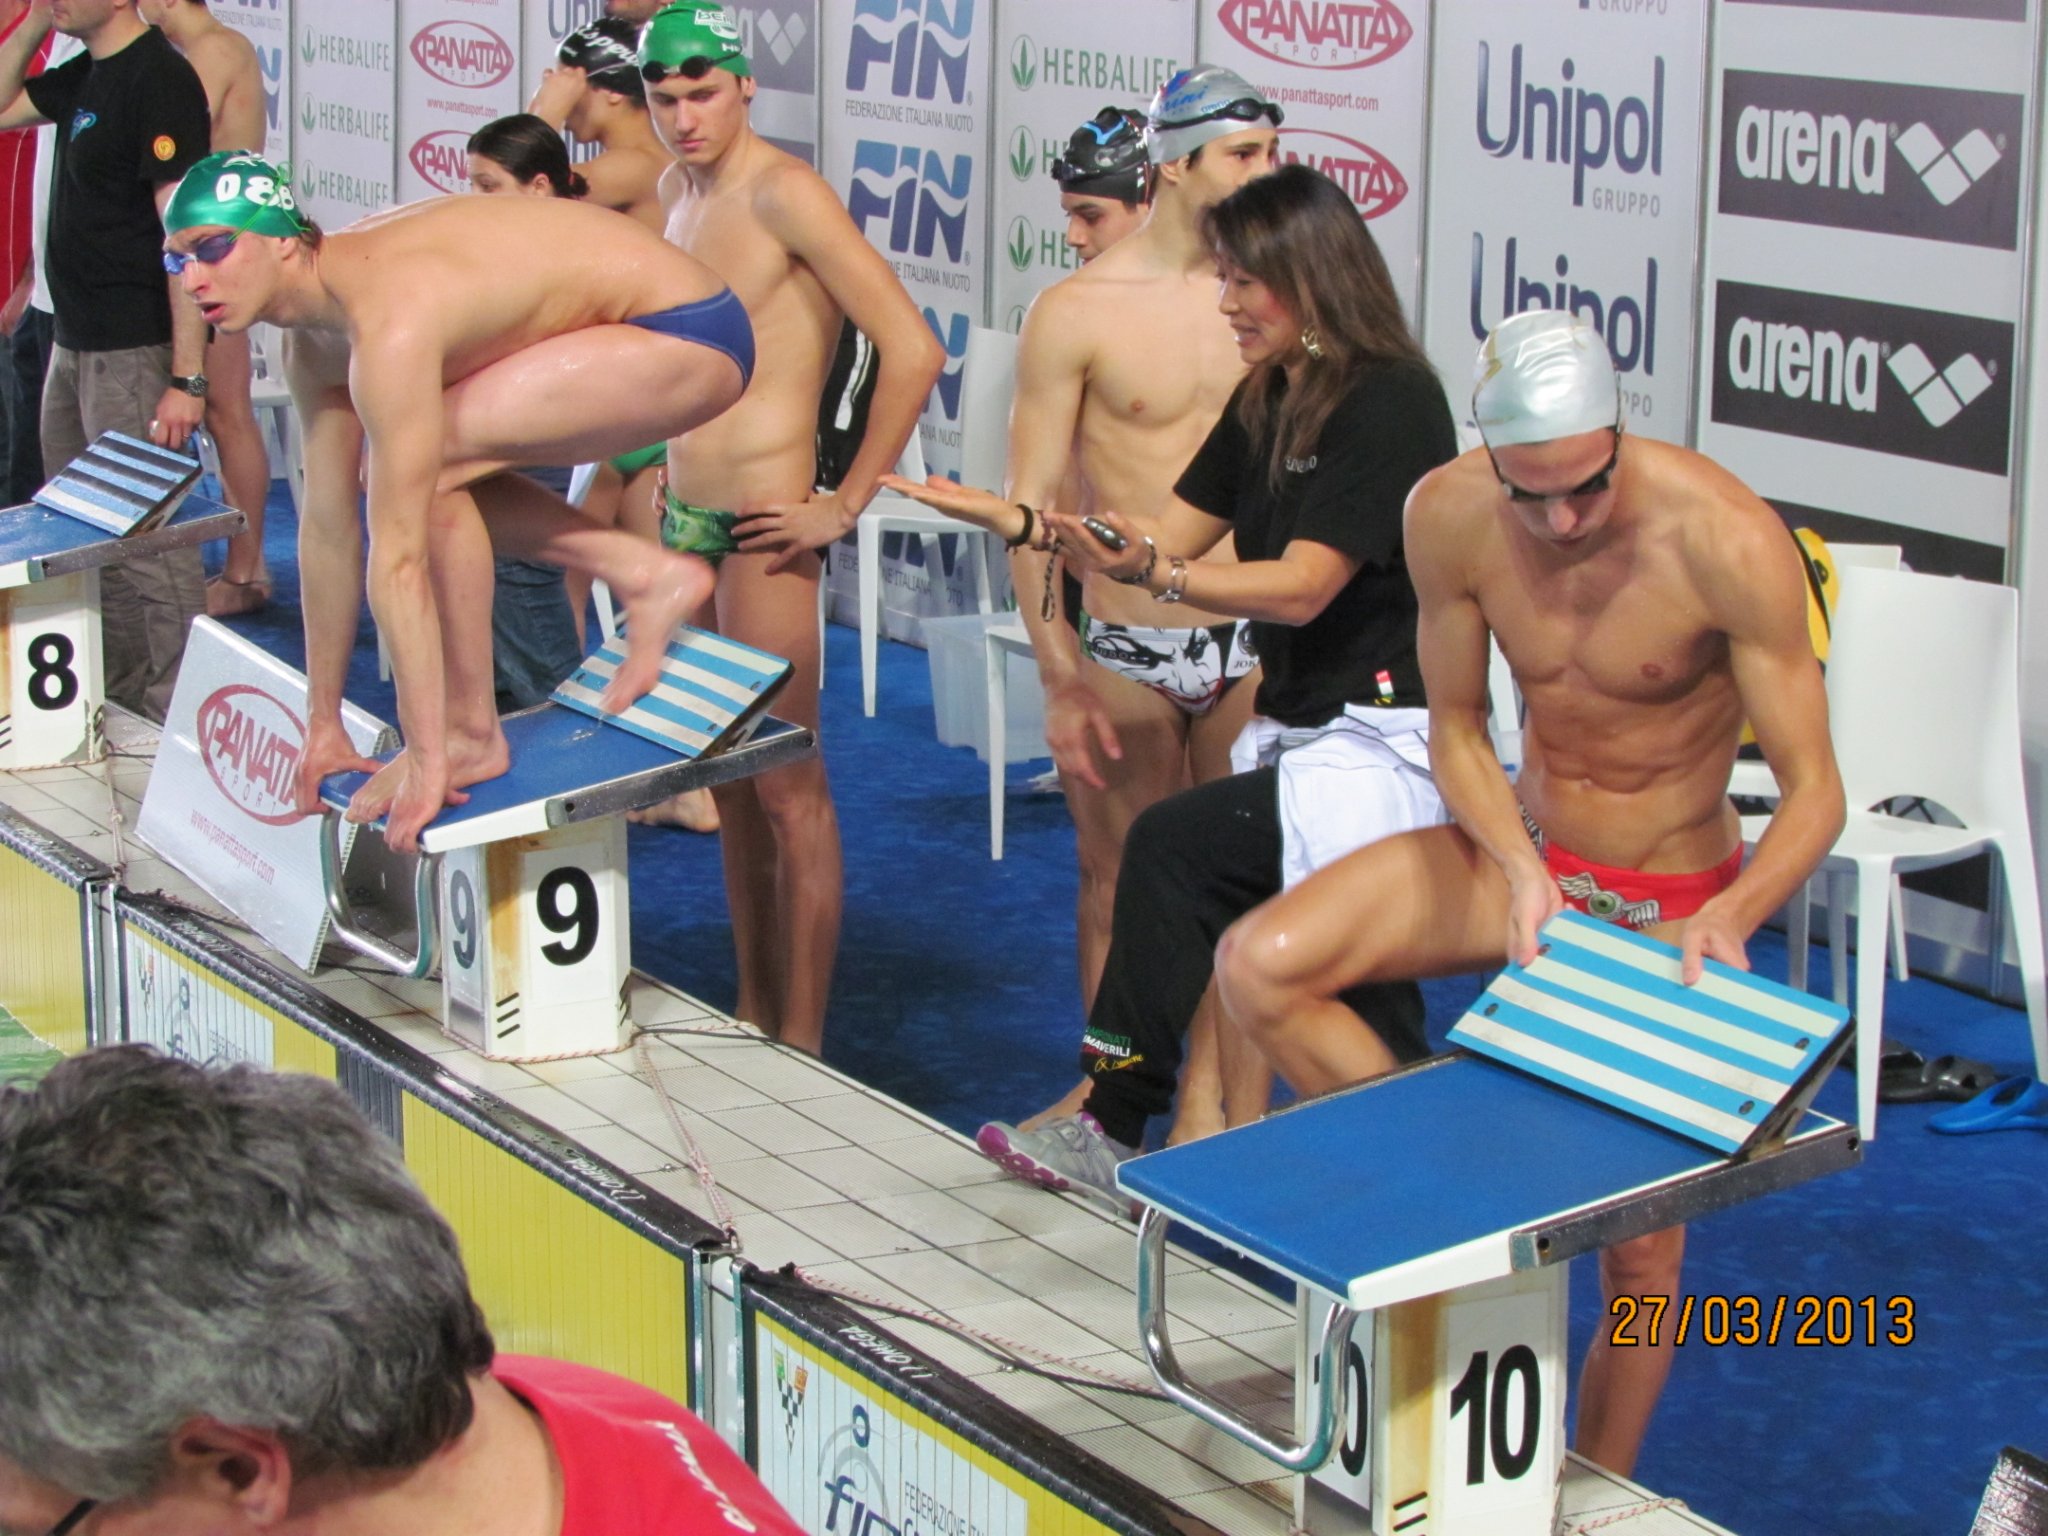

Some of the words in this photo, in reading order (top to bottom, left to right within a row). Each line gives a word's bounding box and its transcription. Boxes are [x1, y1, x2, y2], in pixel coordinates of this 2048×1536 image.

[1243, 0, 1397, 50] PANATTA
[319, 34, 391, 72] HERBALIFE
[419, 34, 507, 75] PANATTA
[1272, 42, 1358, 62] SPORT
[318, 101, 390, 143] HERBALIFE
[426, 97, 499, 119] www.panattasport.com
[845, 99, 903, 122] FEDERAZIONE
[905, 106, 943, 128] ITALIANA
[944, 112, 974, 133] NUOTO
[1476, 40, 1665, 208] Unipol
[1736, 104, 1888, 195] arena
[848, 138, 973, 264] FIN
[1592, 187, 1661, 219] GRUPPO
[902, 262, 940, 286] ITALIANA
[941, 267, 971, 293] NUOTO
[1728, 315, 1880, 414] arena
[938, 427, 962, 449] NUOT
[27, 632, 79, 711] 8
[190, 808, 276, 886] www.panattasport.com
[450, 868, 477, 970] 9
[536, 865, 600, 967] 9
[1449, 1344, 1542, 1487] 10
[904, 1480, 966, 1536] FEDERAZIONE
